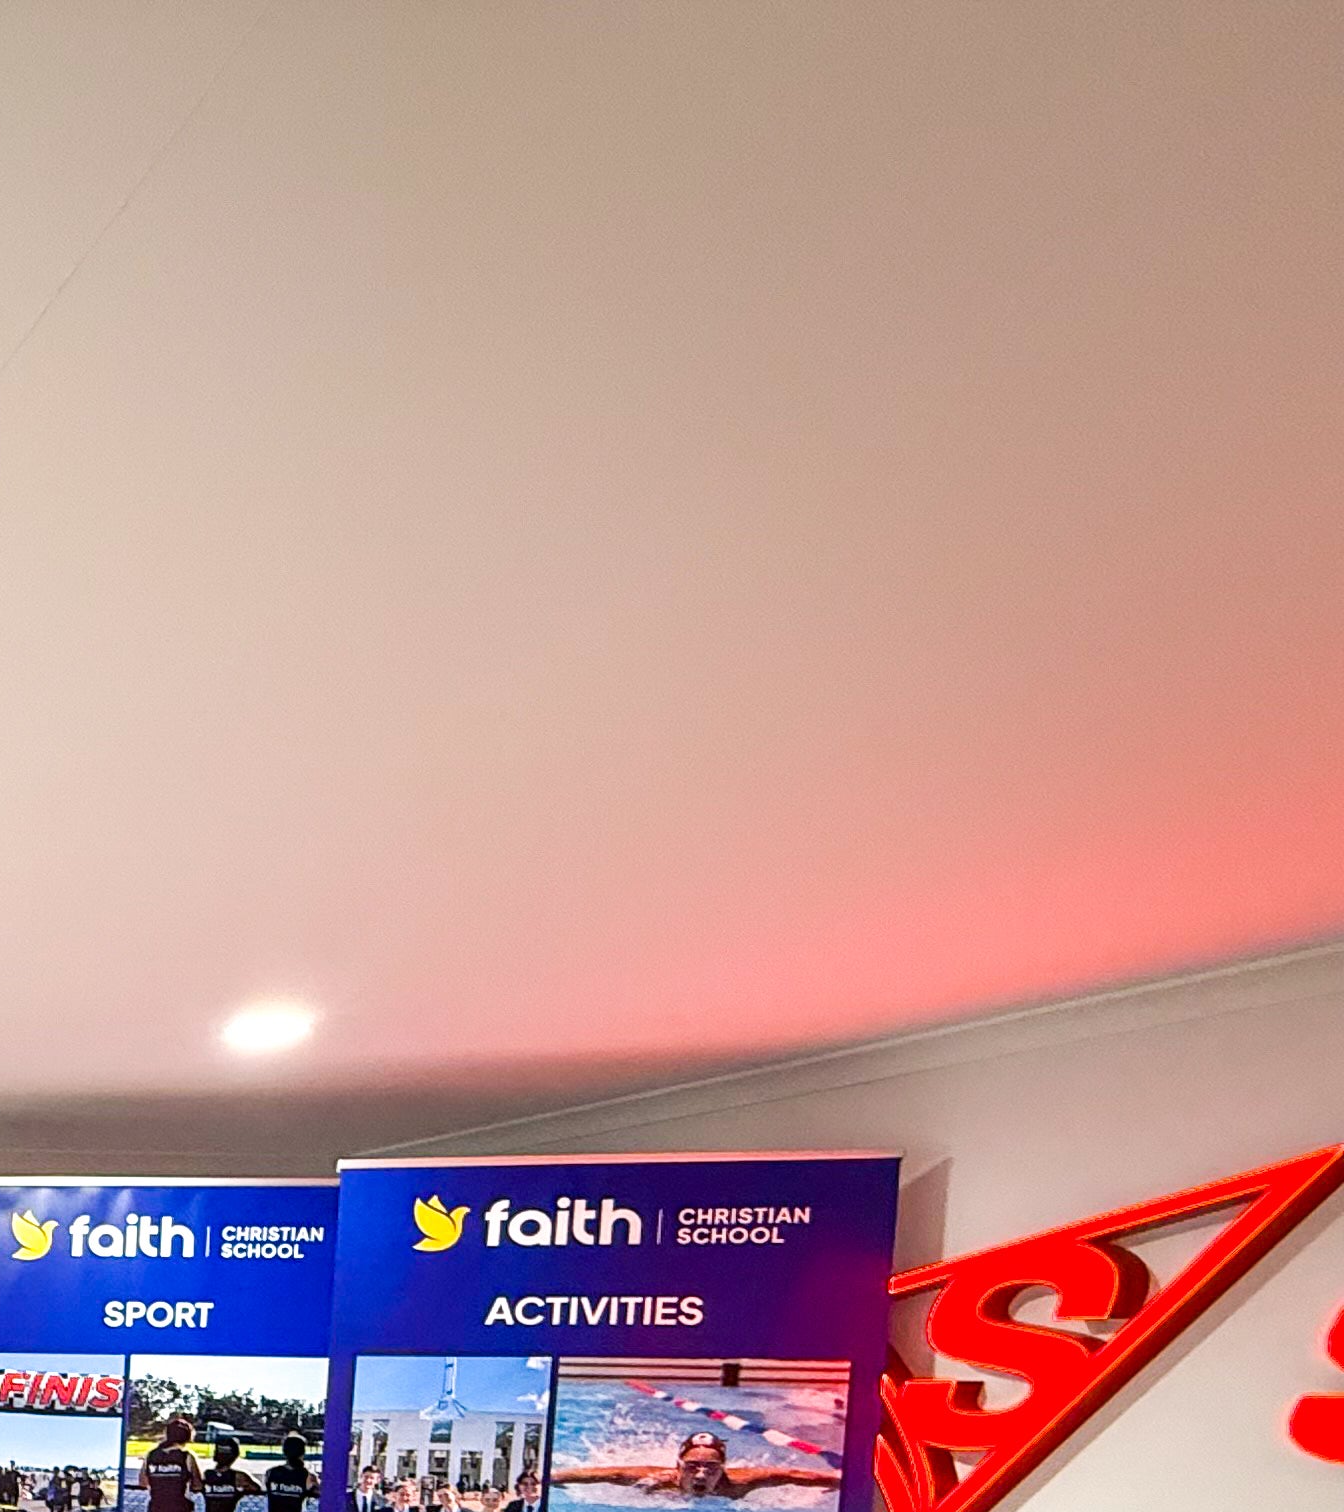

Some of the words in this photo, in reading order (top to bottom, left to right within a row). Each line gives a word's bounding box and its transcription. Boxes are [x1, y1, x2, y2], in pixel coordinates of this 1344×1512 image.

[484, 1196, 642, 1247] faith
[678, 1206, 811, 1225] CHRISTIAN
[69, 1213, 195, 1258] faith
[221, 1225, 325, 1243] CHRISTIAN
[676, 1226, 786, 1245] SCHOOL
[220, 1242, 305, 1259] SCHOOL
[103, 1300, 215, 1328] SPORT
[484, 1295, 704, 1326] ACTIVITIES
